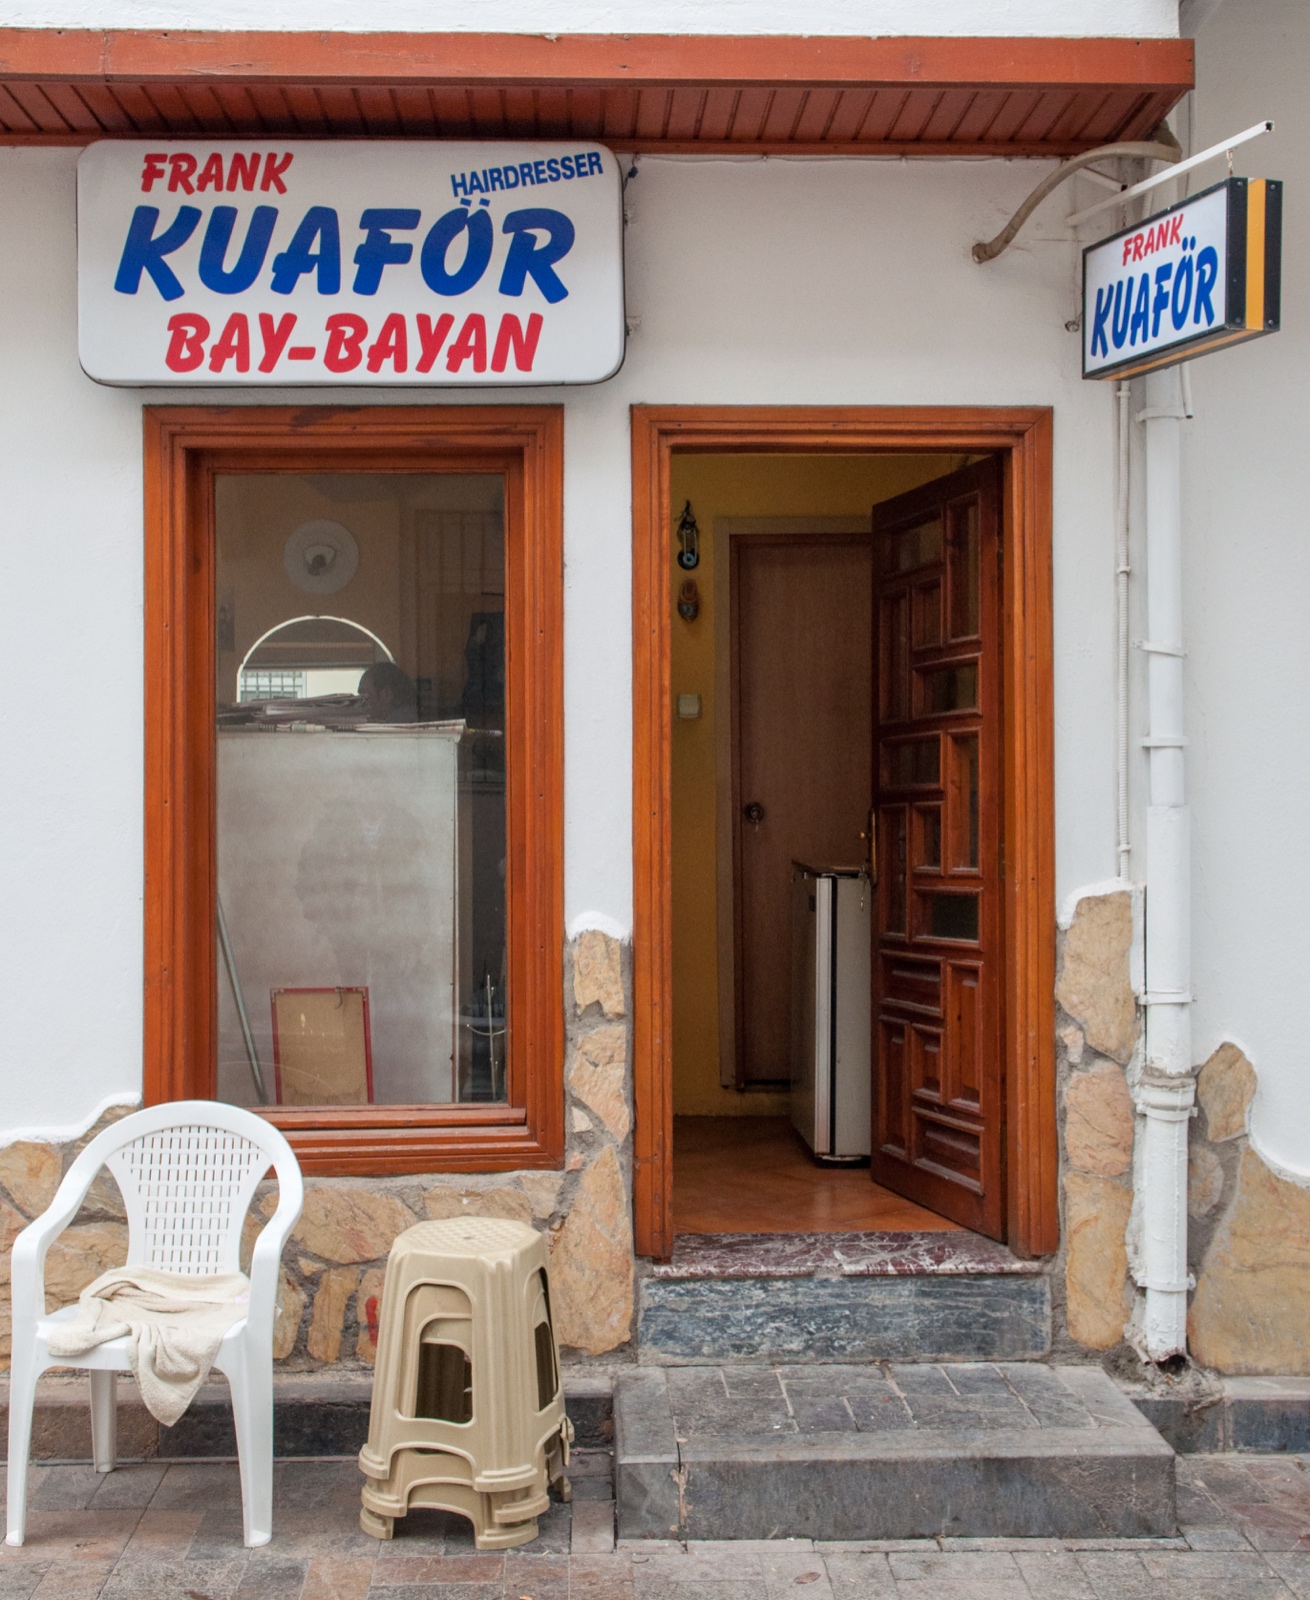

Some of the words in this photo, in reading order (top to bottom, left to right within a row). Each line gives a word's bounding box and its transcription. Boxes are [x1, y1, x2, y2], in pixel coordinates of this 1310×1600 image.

[141, 152, 294, 195] FRANK
[451, 151, 604, 198] HAIRDRESSER
[114, 198, 576, 303] KUAFÖR
[1122, 213, 1184, 266] FRANK
[1091, 236, 1218, 359] KUAFÖR
[165, 312, 543, 374] BAY-BAYAN
